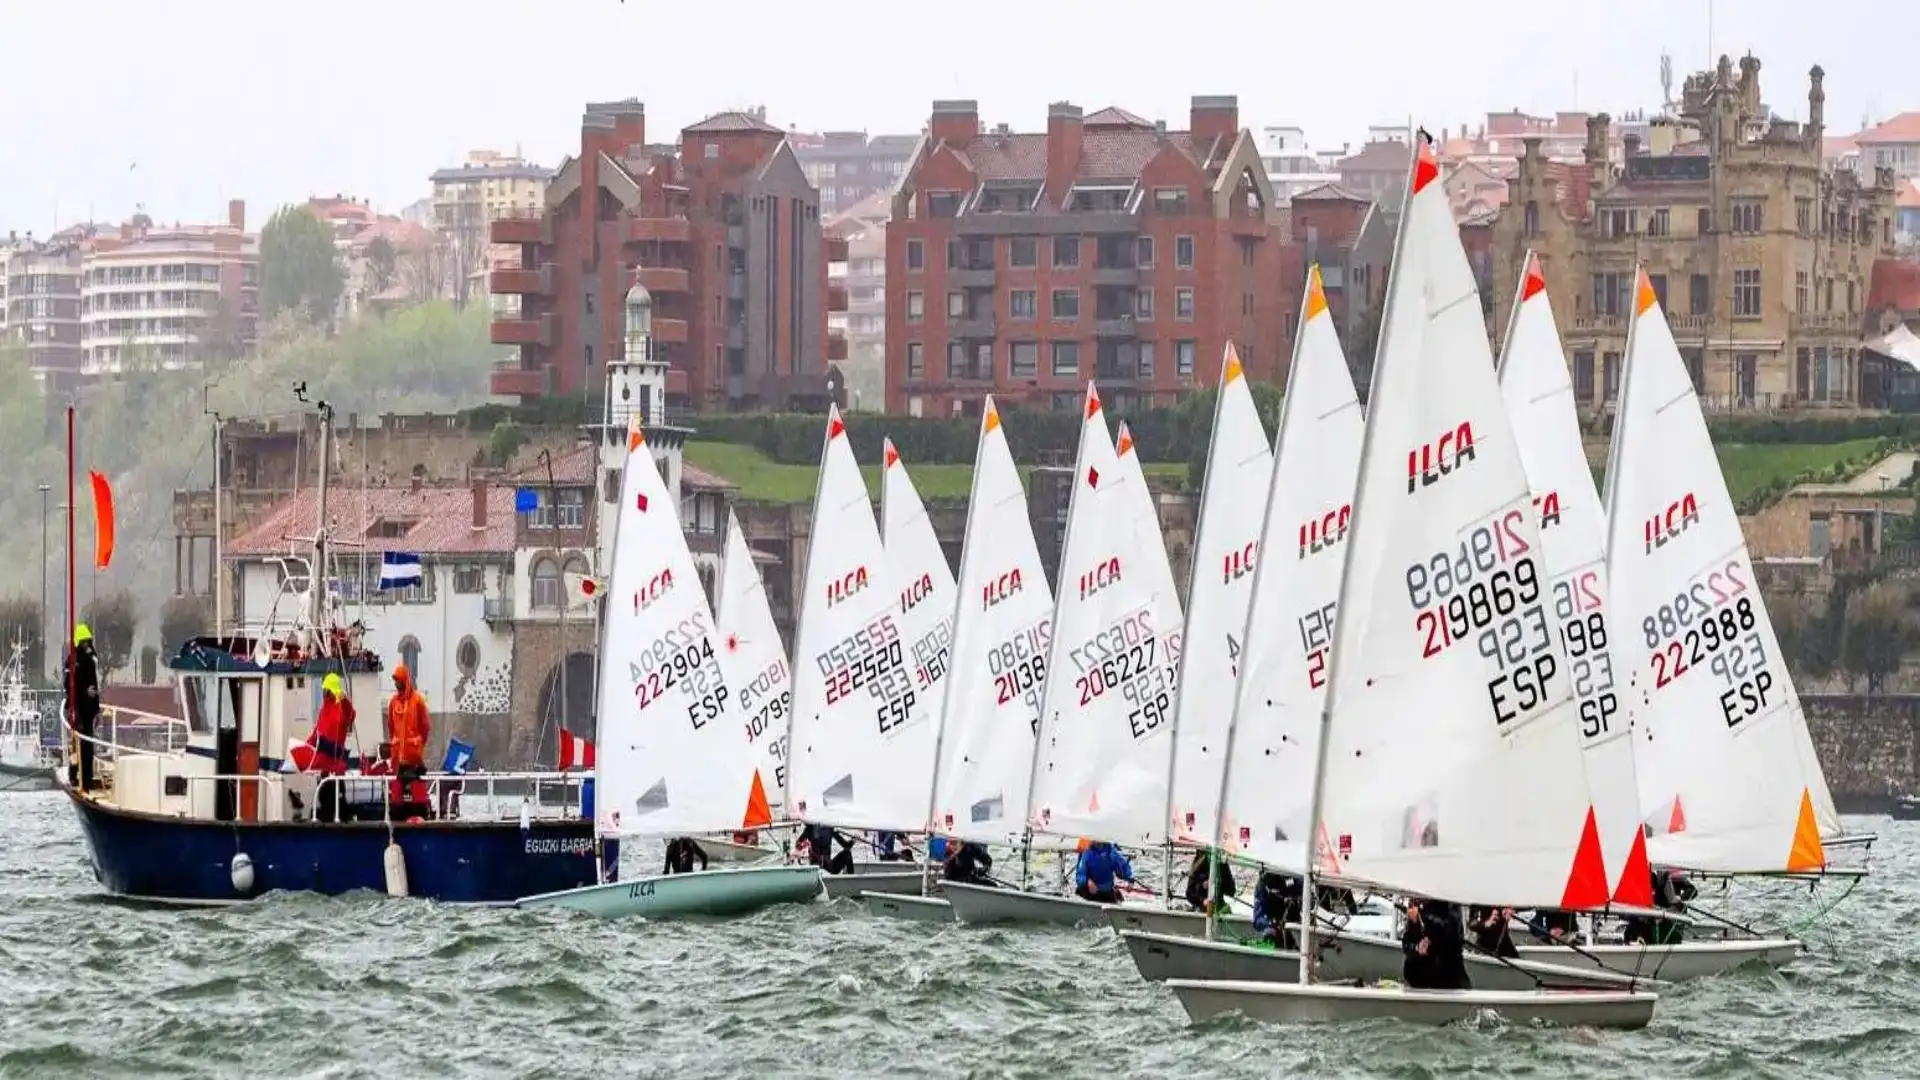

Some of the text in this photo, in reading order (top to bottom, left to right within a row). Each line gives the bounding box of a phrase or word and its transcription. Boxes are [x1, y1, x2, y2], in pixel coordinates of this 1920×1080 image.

[1408, 421, 1476, 494] ILCA
[1299, 504, 1351, 559] ILCA
[1646, 492, 1699, 556] ILCA
[1080, 556, 1121, 601] ILCA
[1224, 540, 1258, 585] ILC
[633, 568, 674, 616] ILCA
[828, 566, 868, 609] ILCA
[901, 572, 933, 614] ILCA
[982, 568, 1022, 612] ILCA
[1416, 557, 1540, 659] 219869
[1650, 597, 1755, 689] 222988
[635, 636, 715, 710] 222904
[825, 639, 902, 705] 222520
[994, 654, 1046, 705] 21138
[1075, 637, 1156, 707] 206227
[1488, 654, 1557, 725] ESP
[688, 685, 729, 730] ESP
[877, 690, 916, 734] ESP
[1128, 692, 1169, 738] ESP
[1579, 692, 1618, 738] SP
[1720, 670, 1772, 728] ESP
[629, 882, 656, 899] ILCA
